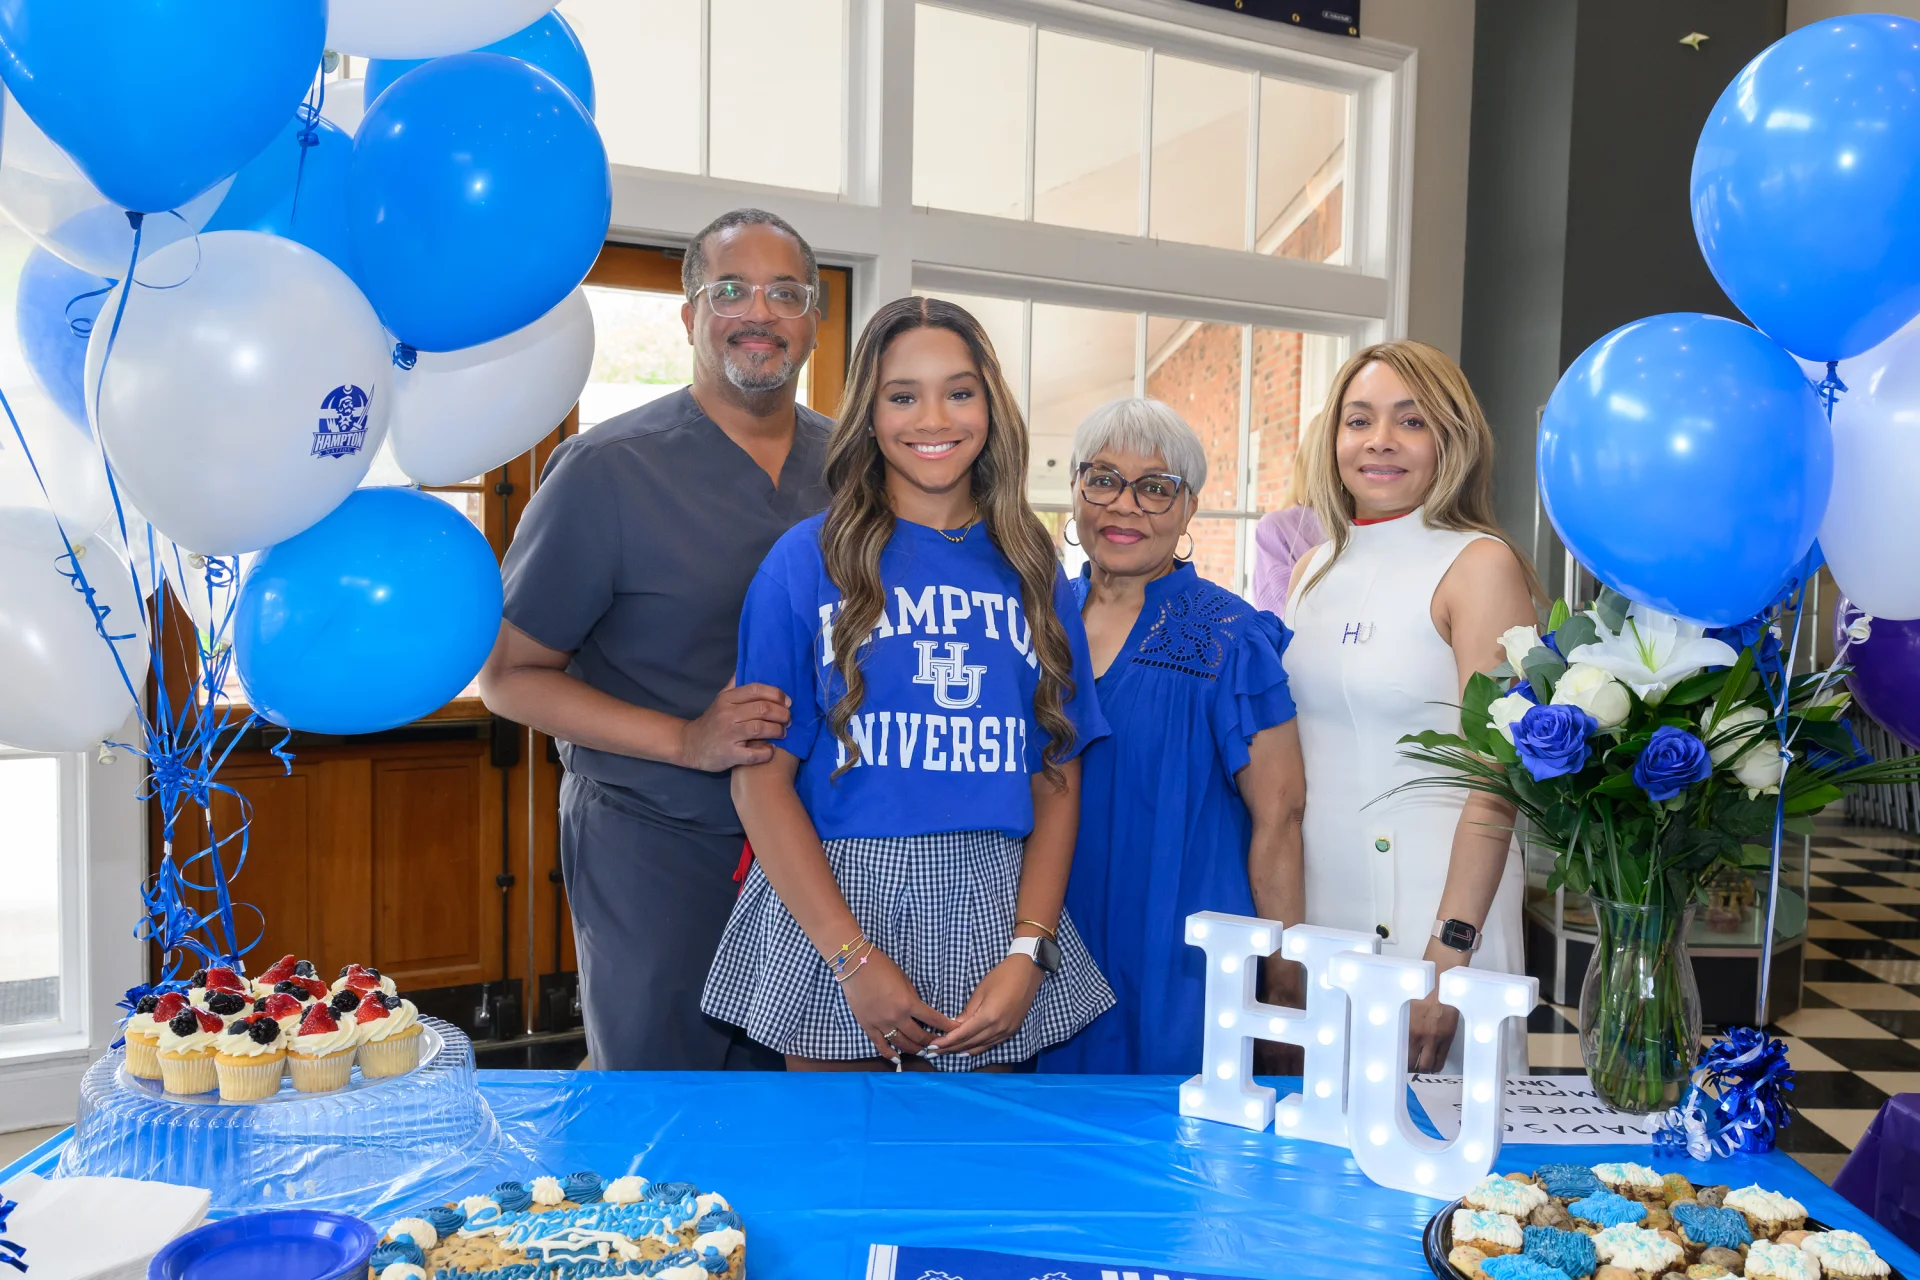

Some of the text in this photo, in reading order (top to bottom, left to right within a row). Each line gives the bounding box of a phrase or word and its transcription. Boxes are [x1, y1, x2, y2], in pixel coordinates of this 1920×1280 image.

[315, 431, 364, 451] HAMPTON
[1342, 621, 1376, 644] HU
[912, 640, 987, 709] HU
[1179, 910, 1540, 1201] HU
